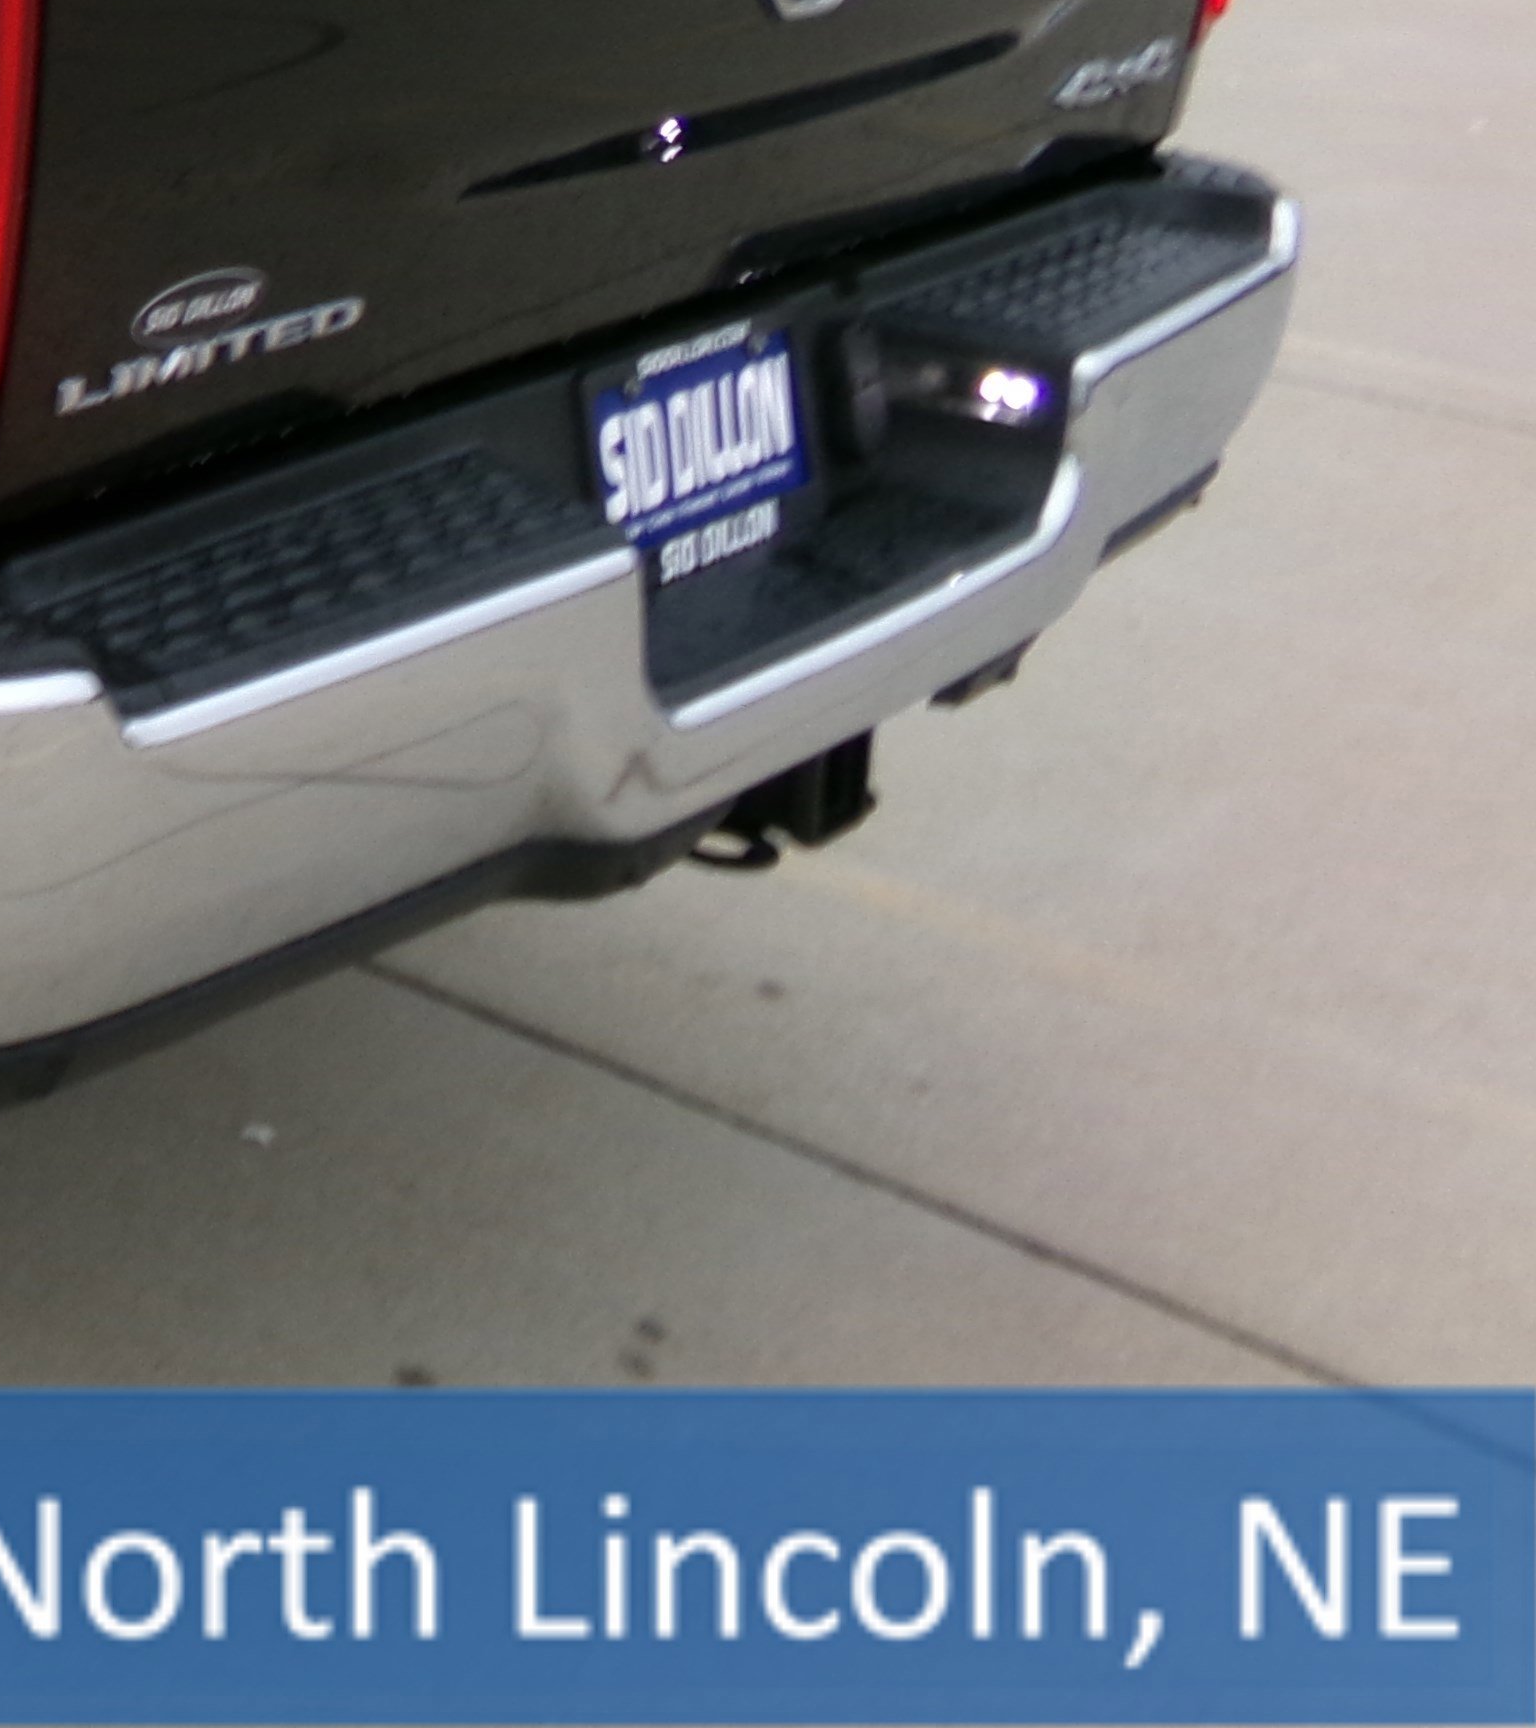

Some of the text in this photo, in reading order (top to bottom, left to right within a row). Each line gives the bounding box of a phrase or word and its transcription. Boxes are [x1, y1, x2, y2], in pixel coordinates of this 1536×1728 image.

[55, 294, 366, 417] LIMITED
[599, 394, 669, 525] SID
[666, 351, 795, 498] DILLON
[660, 528, 698, 586] SID
[699, 496, 780, 568] DILLON
